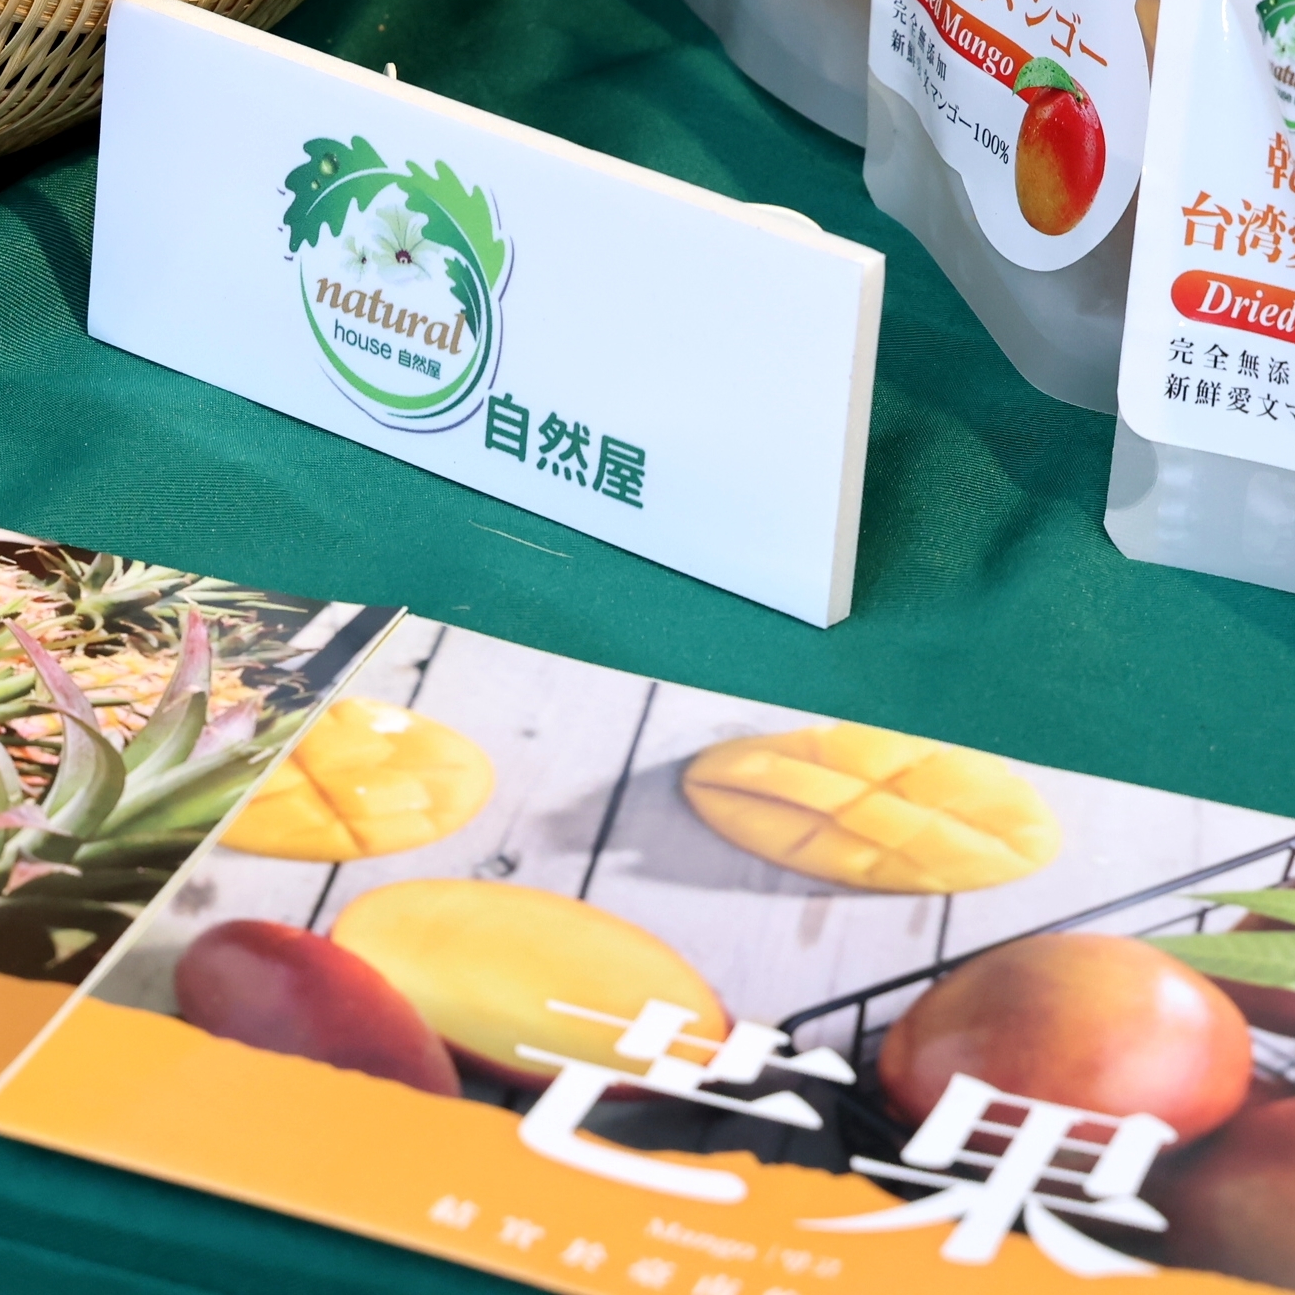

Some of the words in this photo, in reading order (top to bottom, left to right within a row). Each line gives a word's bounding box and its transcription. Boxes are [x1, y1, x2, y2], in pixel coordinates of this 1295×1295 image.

[892, 0, 947, 82] 完全無添加
[942, 2, 1015, 76] Mango
[316, 276, 466, 356] natural
[1196, 280, 1295, 333] Dried
[334, 318, 392, 360] house
[398, 348, 442, 381] 自然屋
[485, 392, 646, 509] 自然屋
[513, 998, 1178, 1278] 芒果
